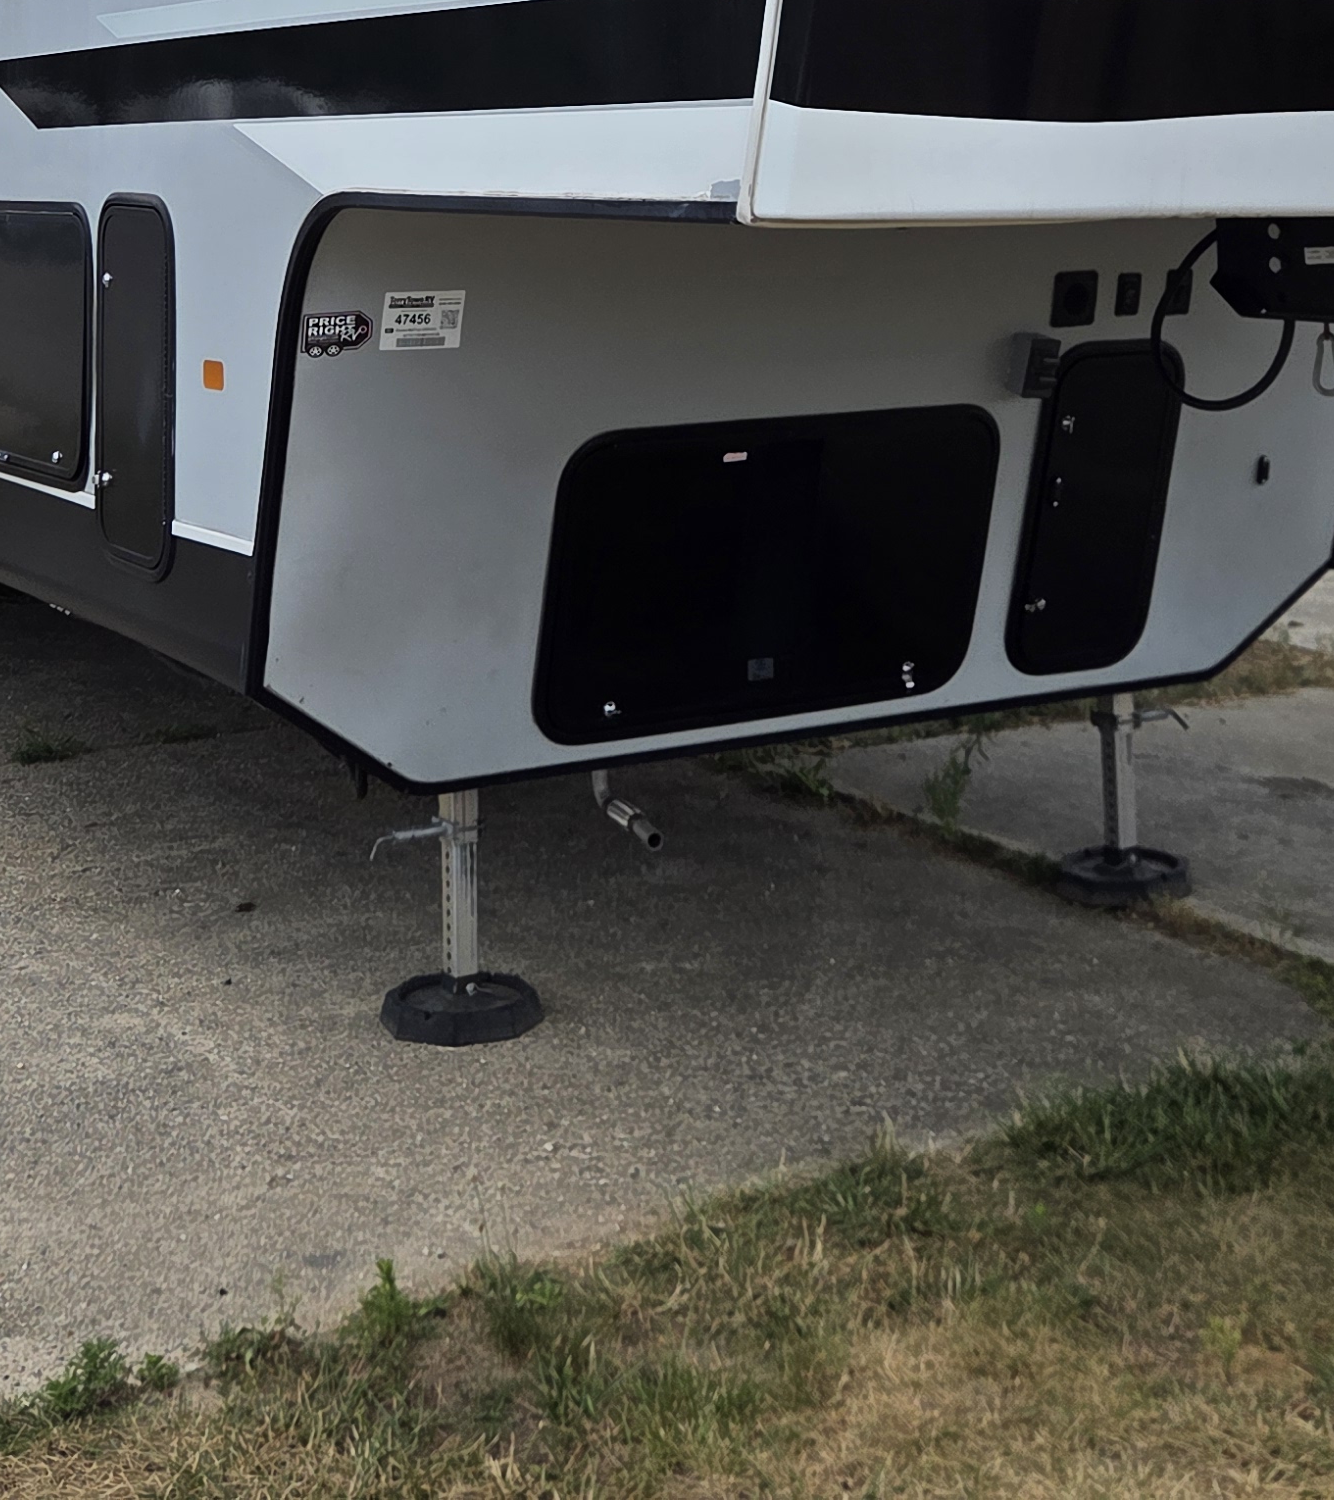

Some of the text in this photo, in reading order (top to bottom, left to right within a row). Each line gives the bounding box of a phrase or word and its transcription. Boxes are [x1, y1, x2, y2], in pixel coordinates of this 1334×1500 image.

[308, 315, 356, 327] PRICE
[394, 313, 431, 325] 47456
[308, 324, 356, 337] RIGHT
